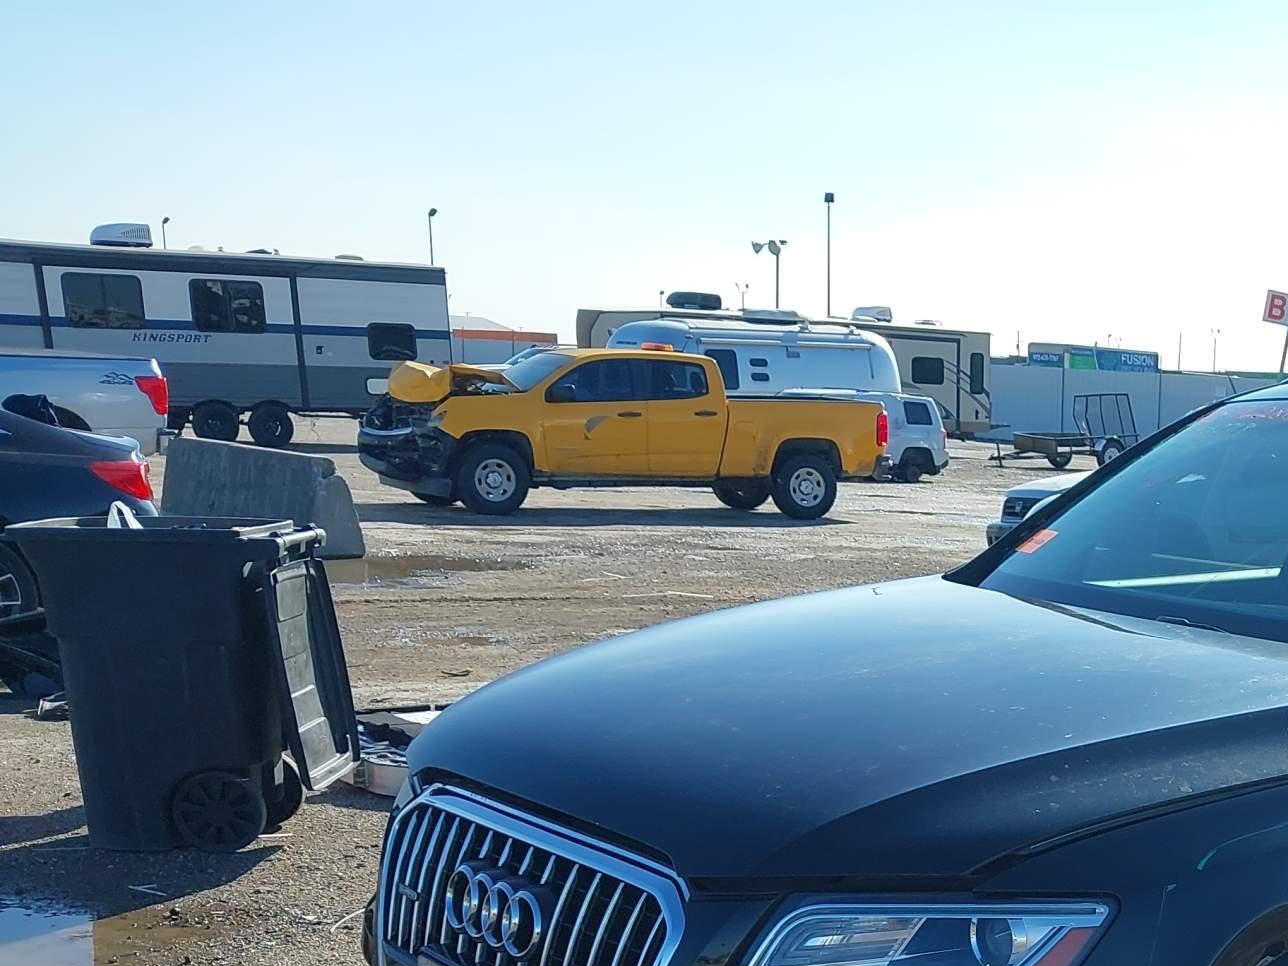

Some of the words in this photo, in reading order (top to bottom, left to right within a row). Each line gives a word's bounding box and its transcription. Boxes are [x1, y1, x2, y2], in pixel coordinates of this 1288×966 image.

[1268, 294, 1287, 320] B
[132, 333, 212, 343] KINGSPORT
[1120, 353, 1155, 366] FUSION
